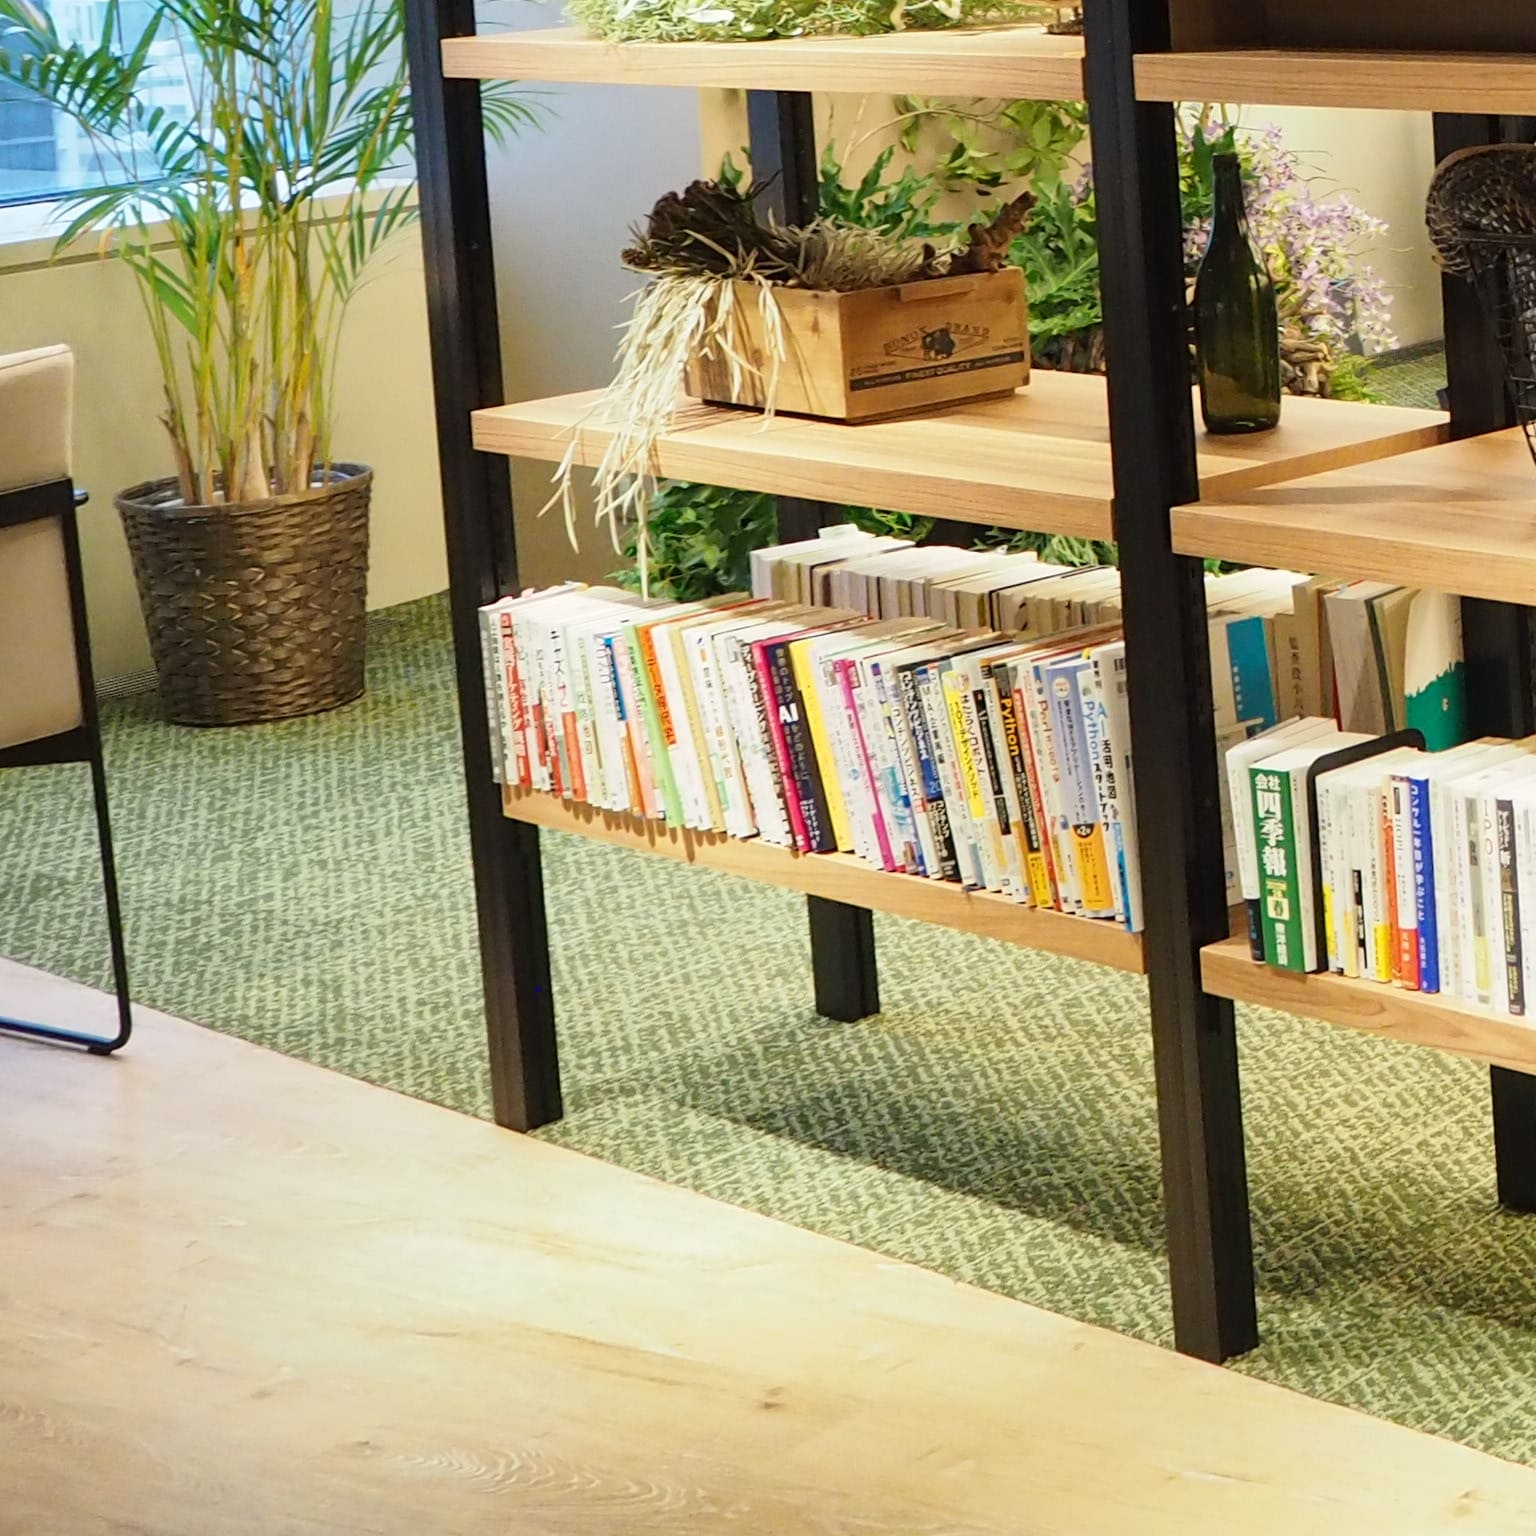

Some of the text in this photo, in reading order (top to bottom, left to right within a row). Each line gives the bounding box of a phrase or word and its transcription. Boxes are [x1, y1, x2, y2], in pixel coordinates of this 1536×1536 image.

[779, 703, 799, 723] AI
[1001, 700, 1019, 757] Python
[1255, 773, 1280, 790] 会社
[1256, 791, 1287, 877] 四季報
